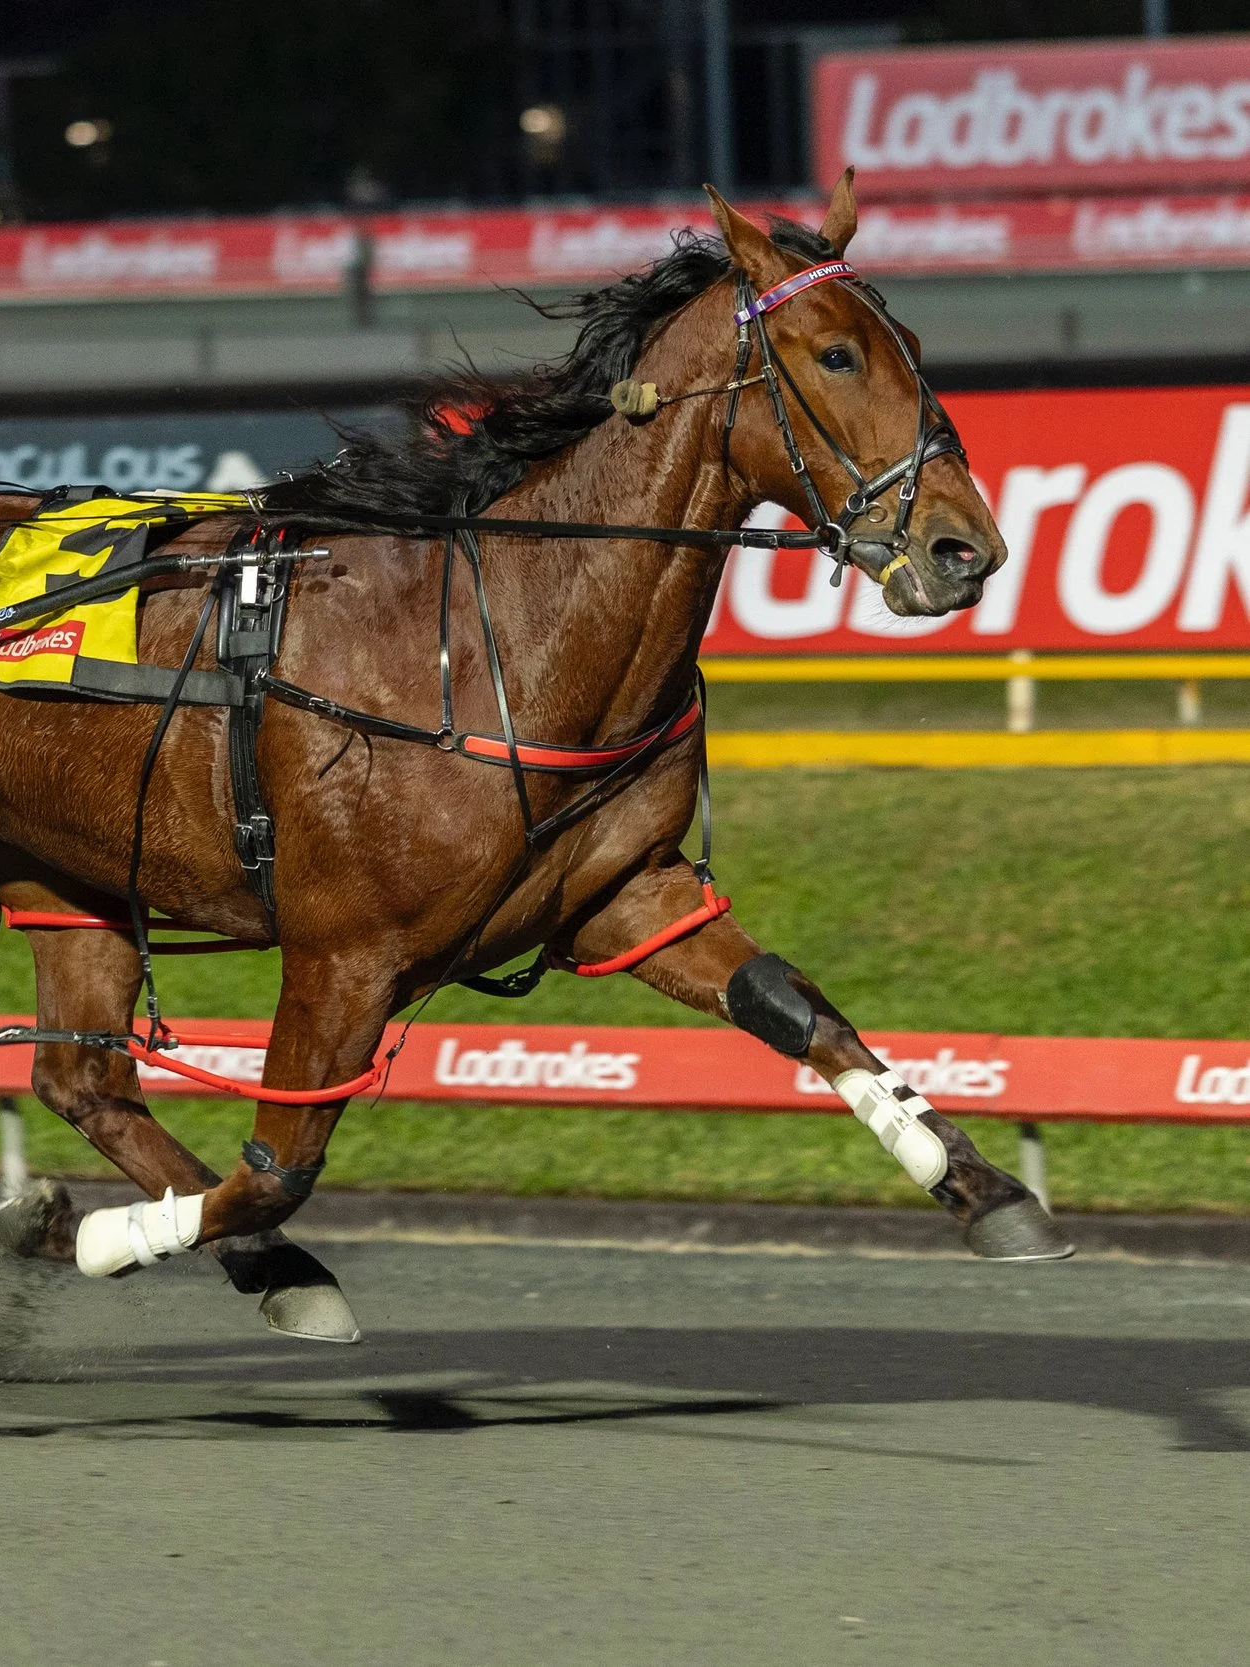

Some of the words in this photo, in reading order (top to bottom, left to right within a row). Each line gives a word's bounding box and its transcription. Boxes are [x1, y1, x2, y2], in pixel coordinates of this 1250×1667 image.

[843, 63, 1250, 172] Ladbrokes
[809, 264, 844, 280] HEWITT
[434, 1038, 642, 1090] Ladbrokes
